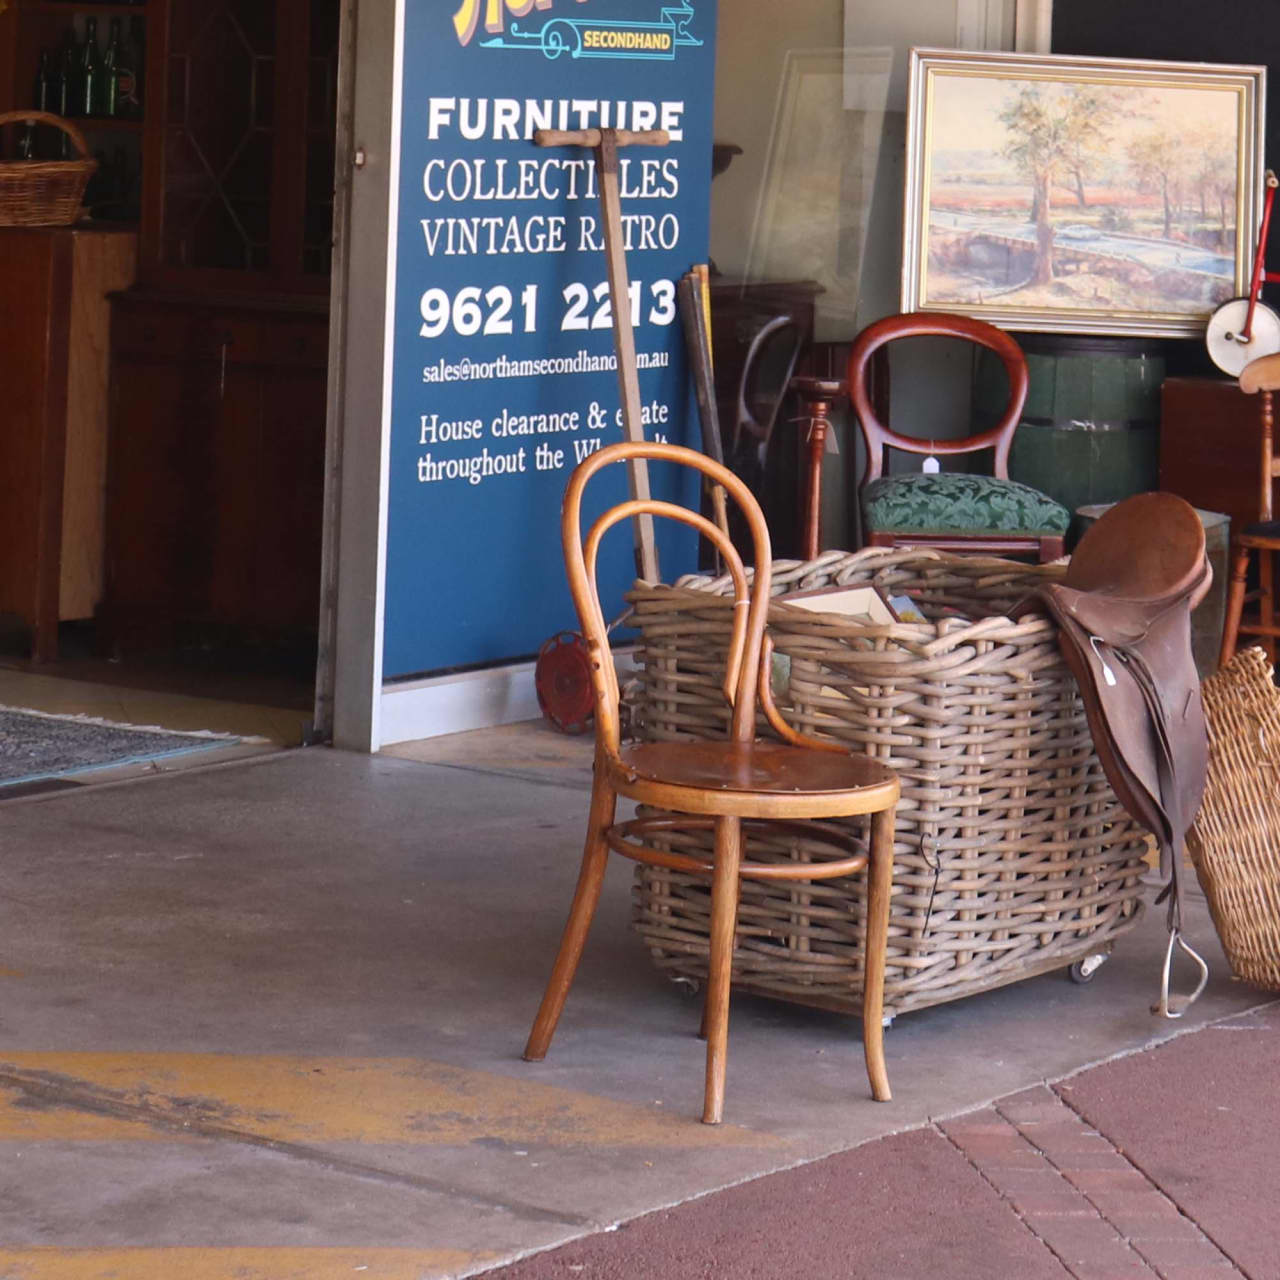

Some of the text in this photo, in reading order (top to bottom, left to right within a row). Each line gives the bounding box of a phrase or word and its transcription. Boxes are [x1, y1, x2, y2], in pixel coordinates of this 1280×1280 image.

[583, 30, 671, 50] SECONDHAND
[427, 97, 685, 142] FURNITURE
[422, 158, 679, 202] COLLECTILES
[420, 213, 680, 257] VINTAGE RTRO
[419, 278, 677, 338] 9621 2213
[419, 400, 669, 445] House clearance & eate
[417, 447, 527, 485] throughout
[535, 442, 565, 471] the
